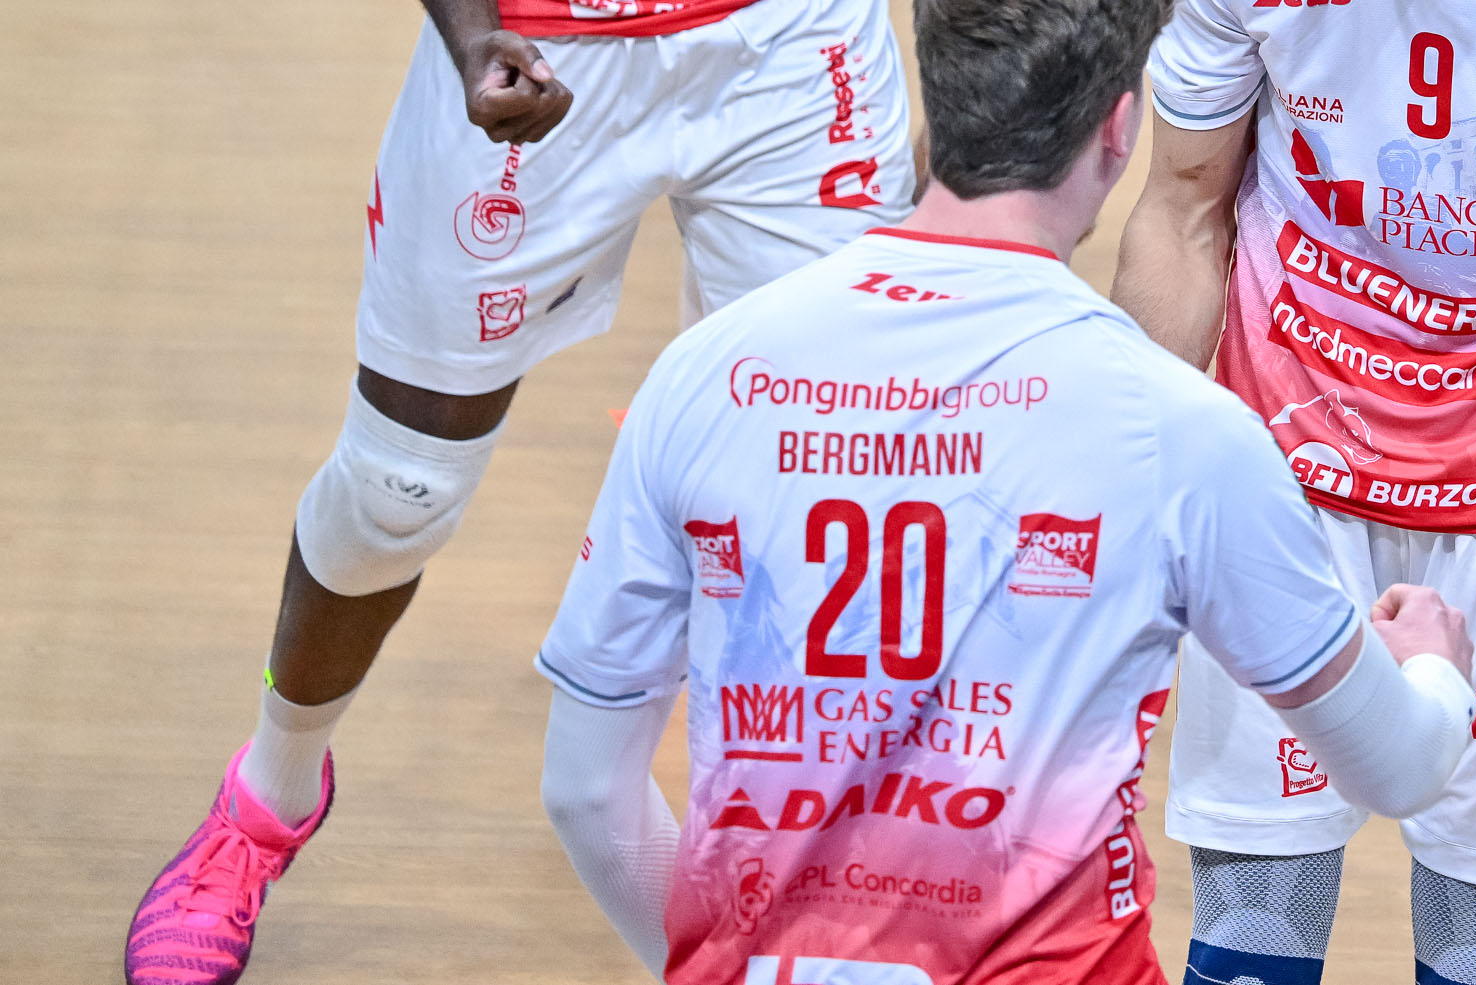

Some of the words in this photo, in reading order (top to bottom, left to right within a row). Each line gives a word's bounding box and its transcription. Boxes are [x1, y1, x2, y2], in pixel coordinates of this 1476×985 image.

[1277, 88, 1344, 113] LIANA
[1406, 31, 1454, 139] 9
[1283, 104, 1344, 124] RAZIONI
[499, 144, 524, 192] gran
[778, 430, 984, 476] BERGMANN
[1017, 530, 1095, 552] SPORT
[804, 498, 948, 681] 20
[814, 688, 894, 723] GAS
[910, 678, 1014, 717] SALES
[818, 715, 1007, 765] ENERGIA
[776, 772, 1007, 832] DAIKO
[1289, 777, 1315, 790] Progetto
[844, 862, 983, 905] Concordia
